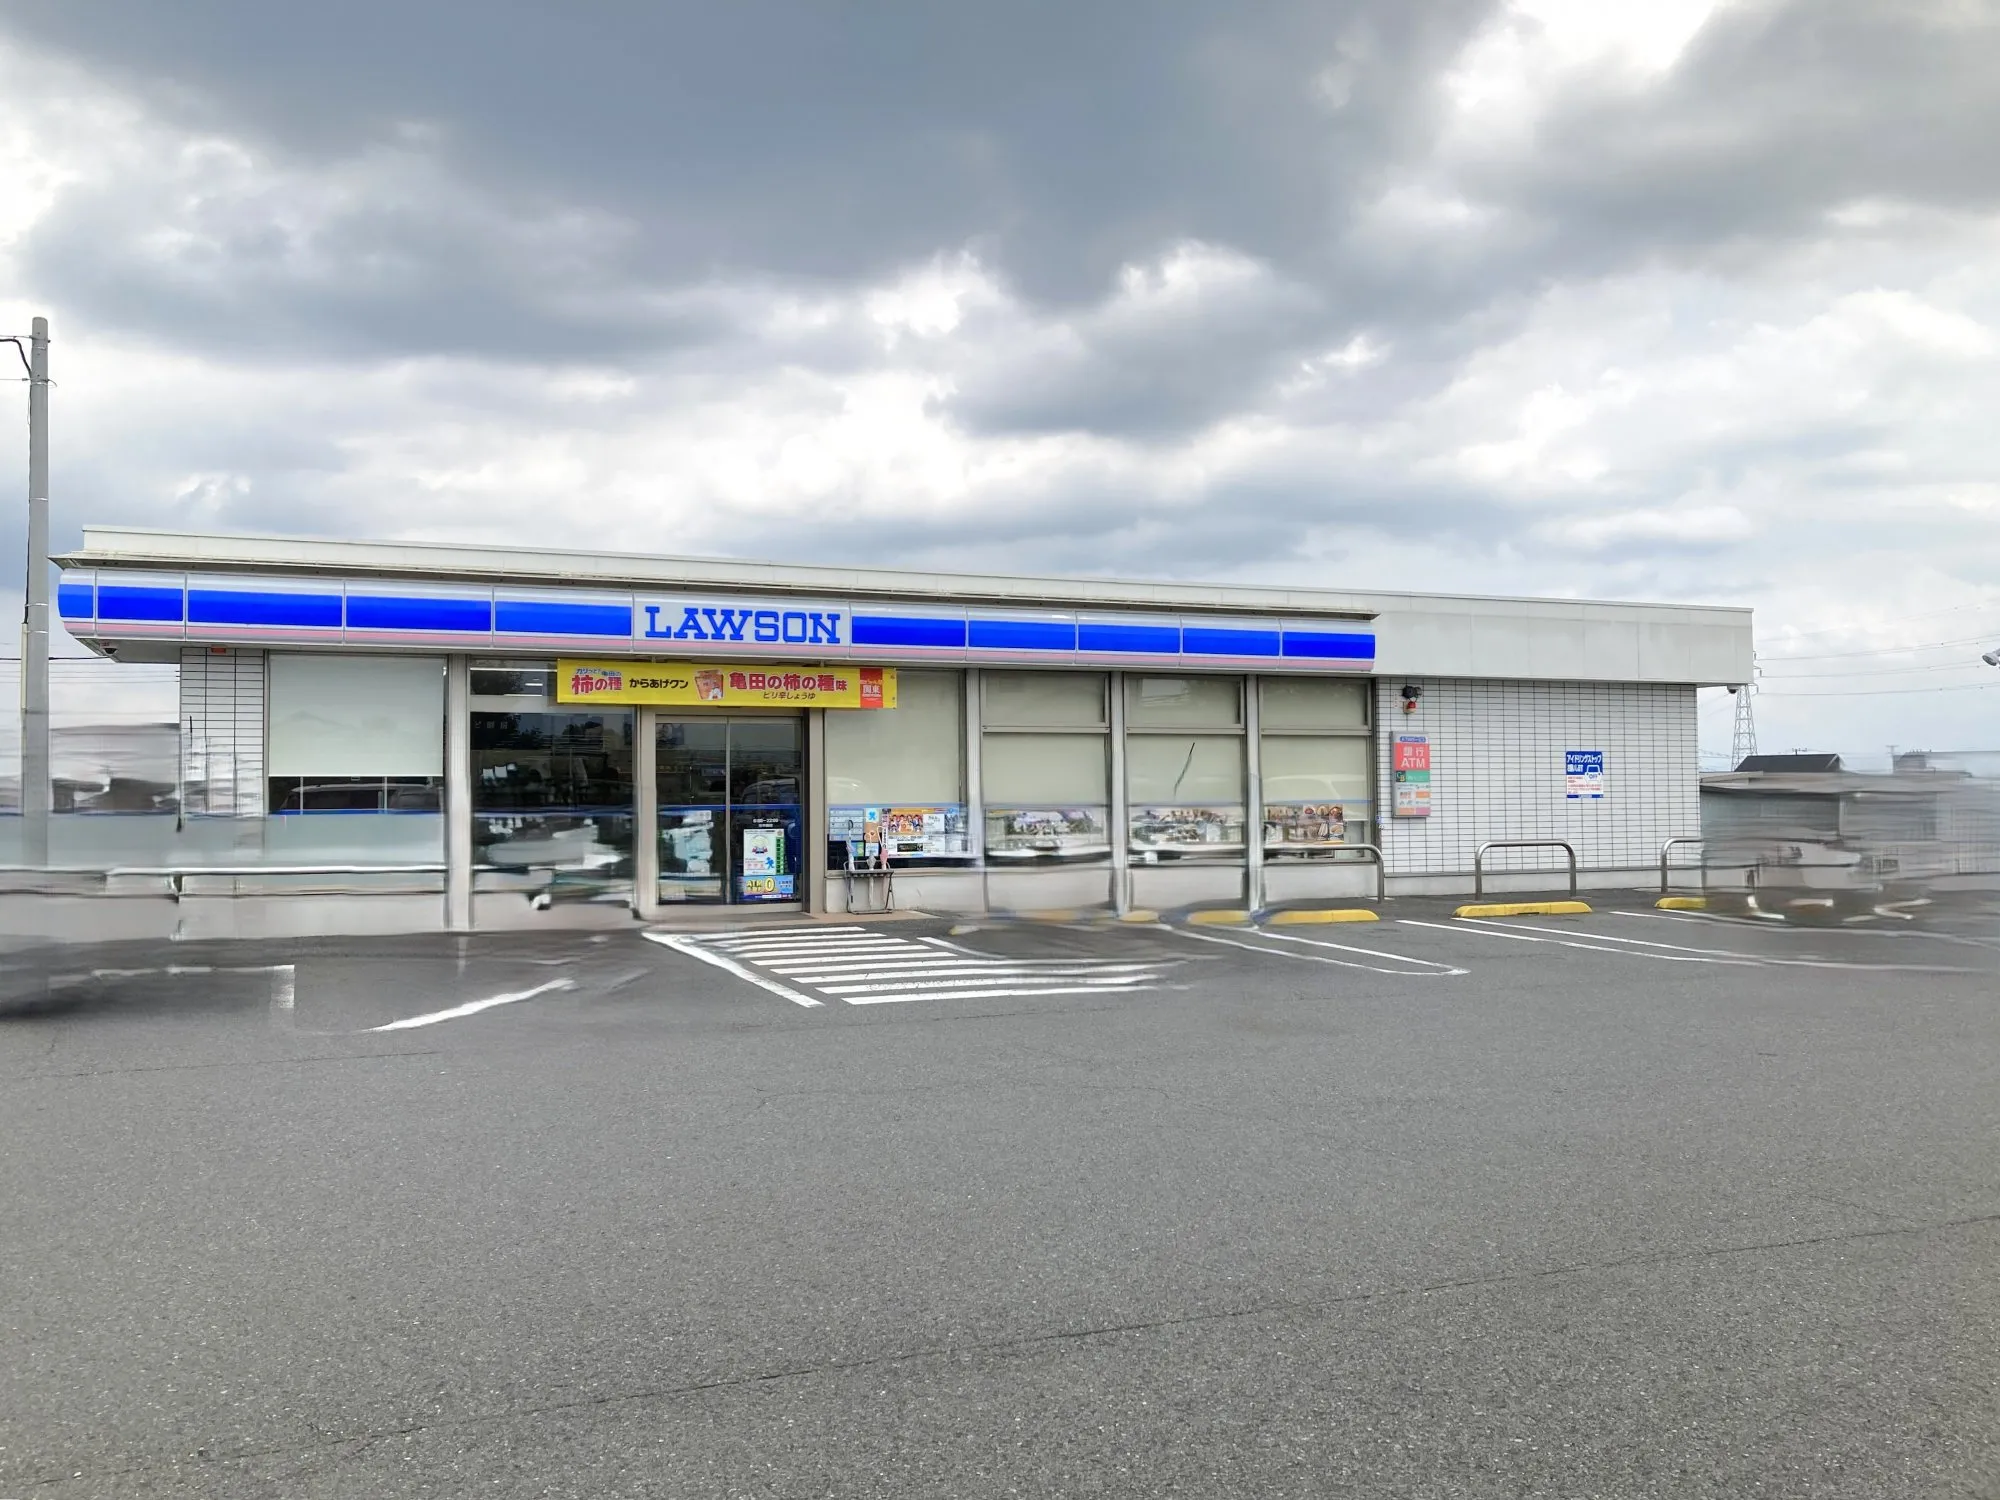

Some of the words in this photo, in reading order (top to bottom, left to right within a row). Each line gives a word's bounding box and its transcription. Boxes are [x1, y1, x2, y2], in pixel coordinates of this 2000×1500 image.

[645, 606, 840, 644] LAWSON
[571, 675, 622, 695] 柿の種
[629, 678, 689, 689] からあげクン
[1401, 758, 1425, 768] ATM
